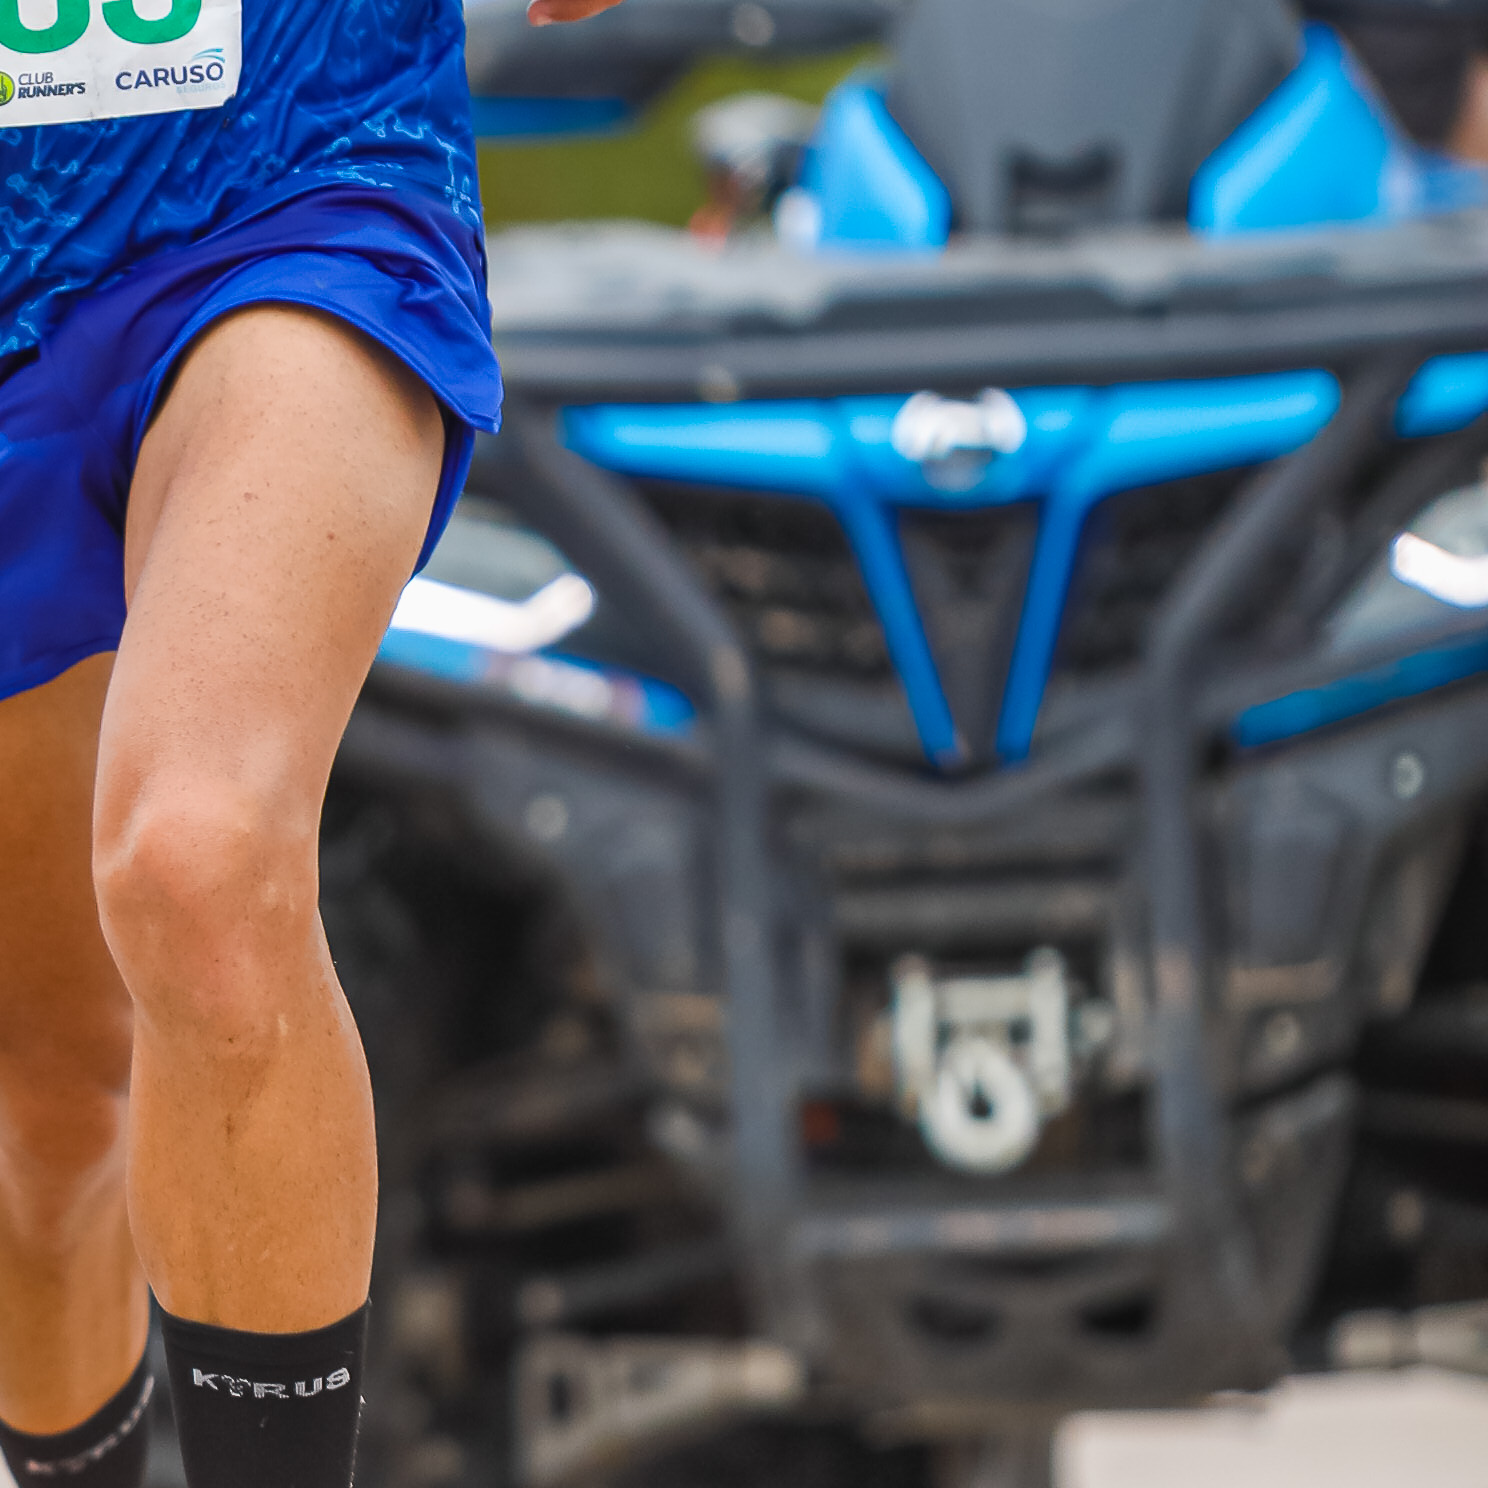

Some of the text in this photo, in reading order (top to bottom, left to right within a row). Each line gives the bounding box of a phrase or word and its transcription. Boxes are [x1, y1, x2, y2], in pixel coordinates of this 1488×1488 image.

[17, 71, 54, 86] CLUB
[115, 61, 225, 90] CARUSO
[17, 81, 86, 99] RUNNER'S
